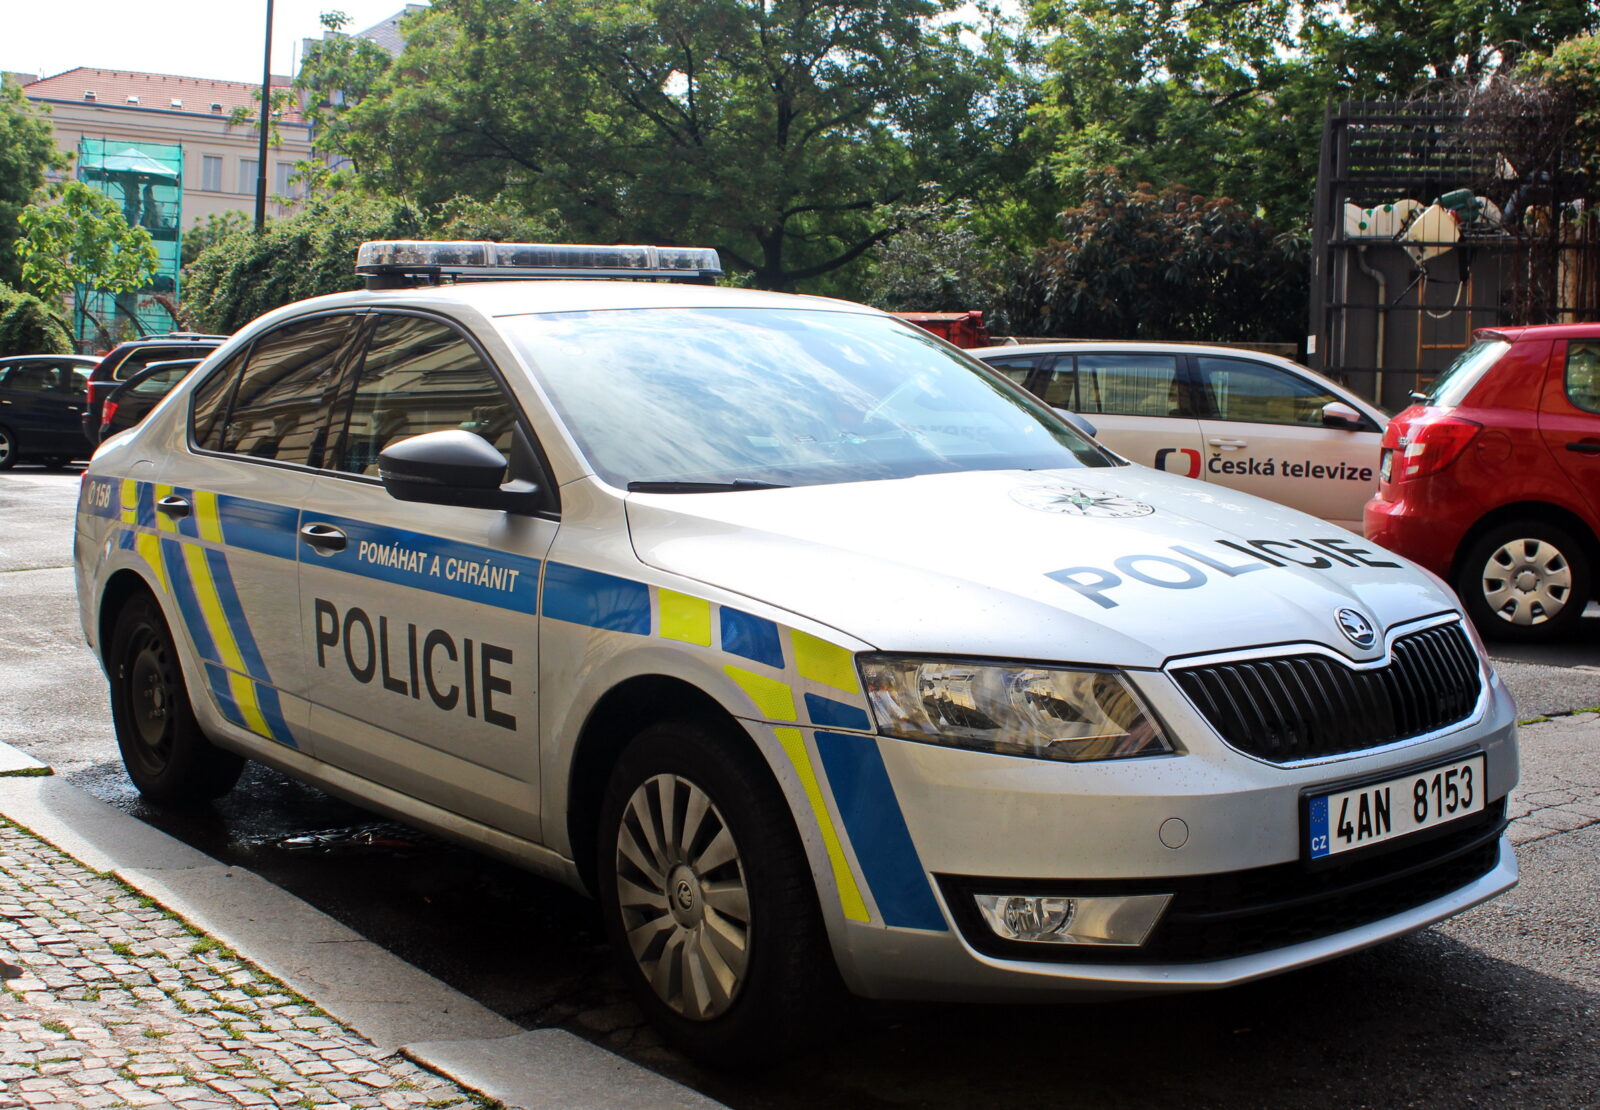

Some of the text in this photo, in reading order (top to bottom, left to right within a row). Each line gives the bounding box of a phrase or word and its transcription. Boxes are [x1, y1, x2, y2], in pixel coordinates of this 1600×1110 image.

[1208, 453, 1275, 476] Česká
[1281, 460, 1373, 481] televize
[358, 540, 519, 593] POMÁHAT A CHRÁNIT
[1043, 538, 1404, 609] POLICIE
[314, 597, 517, 732] POLICIE
[1337, 765, 1473, 844] 4AN 8153
[1311, 834, 1327, 852] CZ
